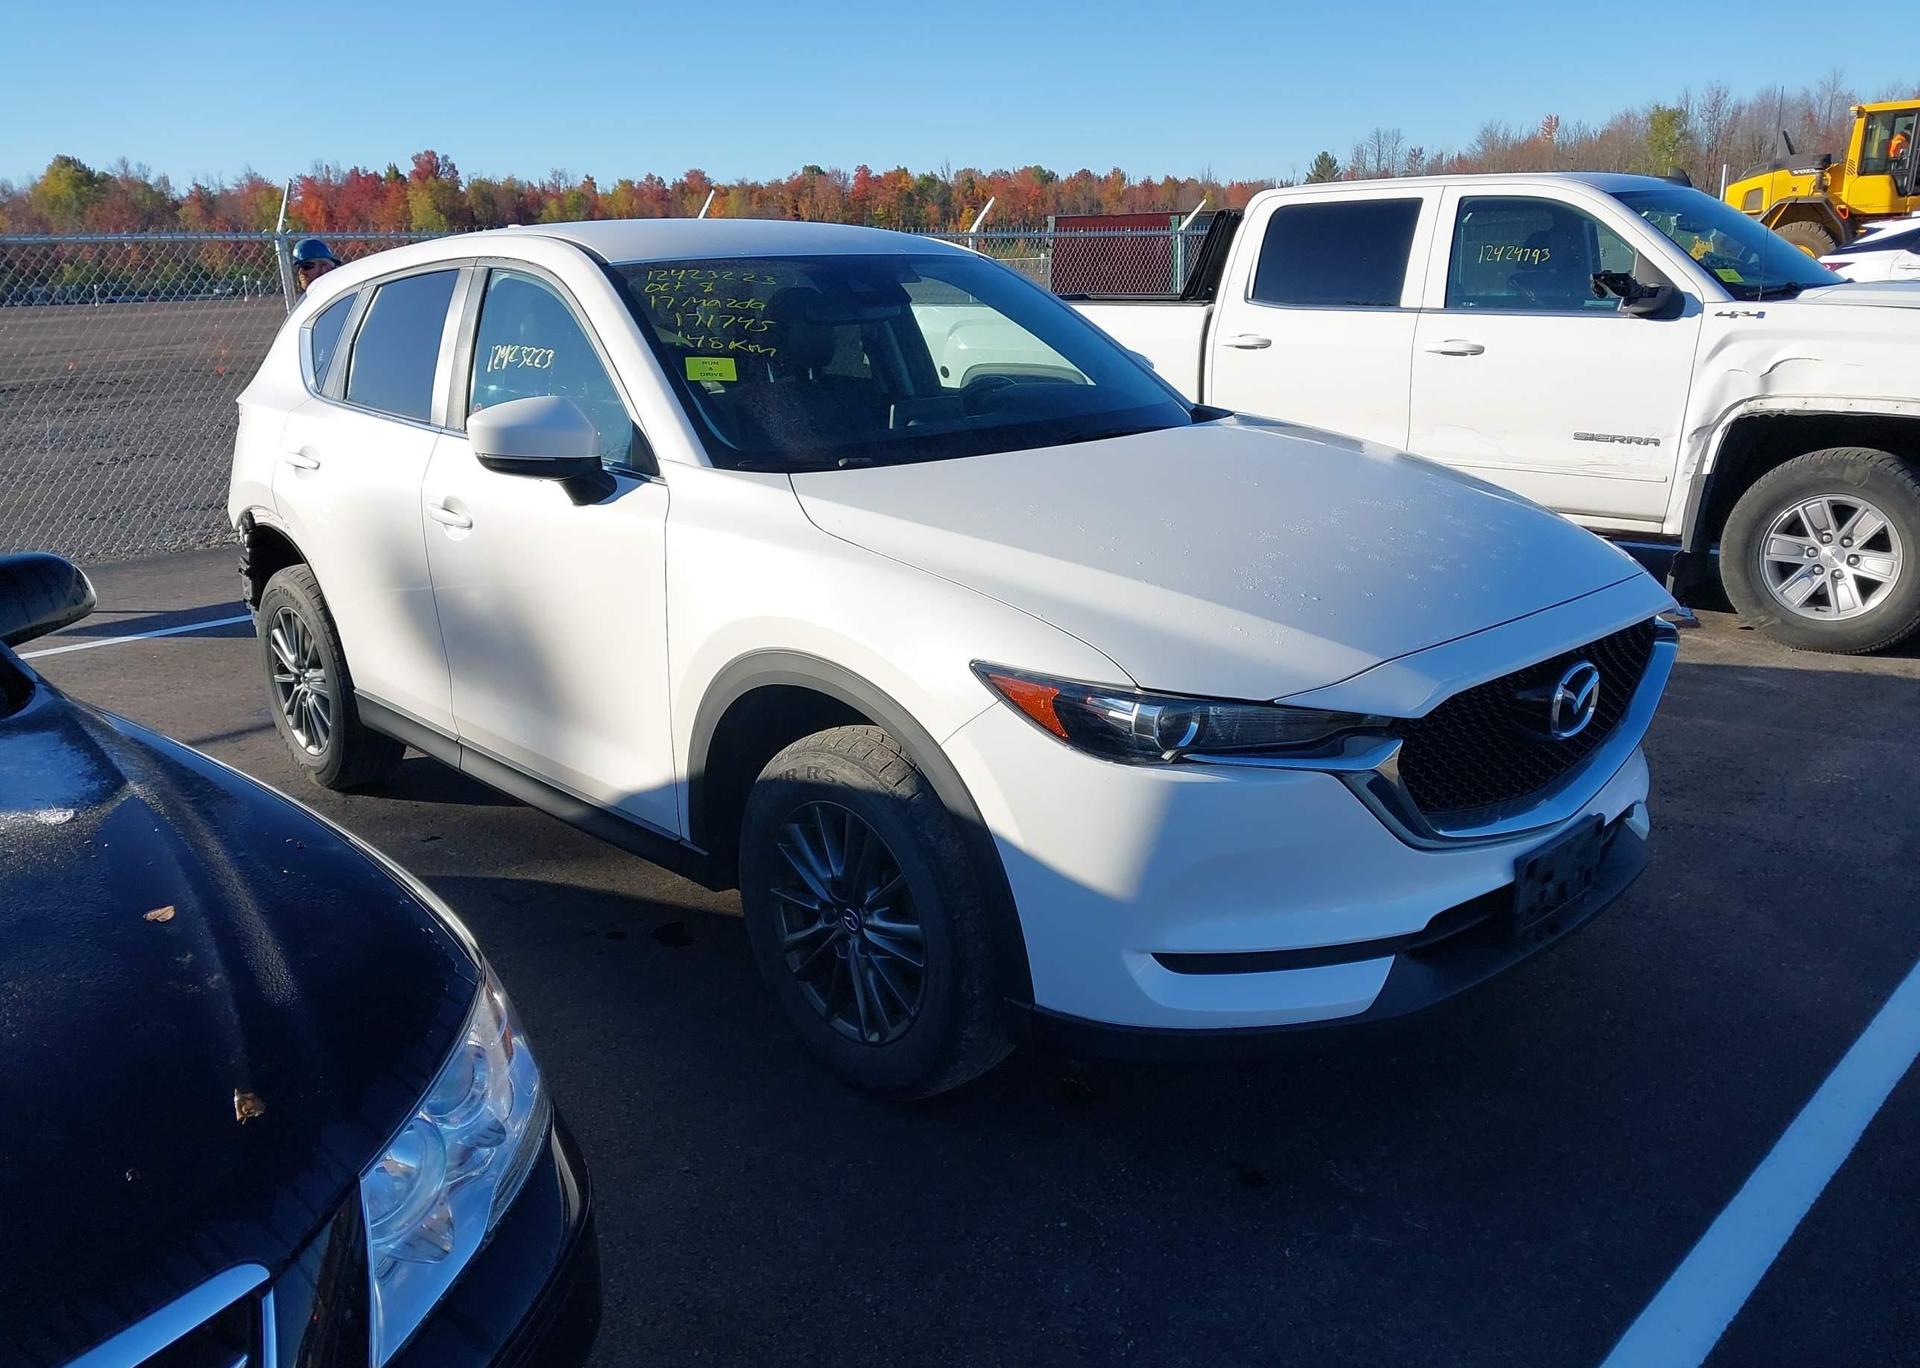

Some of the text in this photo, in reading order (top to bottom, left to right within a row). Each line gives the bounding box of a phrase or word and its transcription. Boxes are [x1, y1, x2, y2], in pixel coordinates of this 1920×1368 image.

[1479, 245, 1551, 265] 12424793
[647, 270, 777, 285] 12423223
[651, 296, 674, 309] 17
[487, 344, 554, 373] 12423223
[1573, 432, 1661, 447] SIERRA
